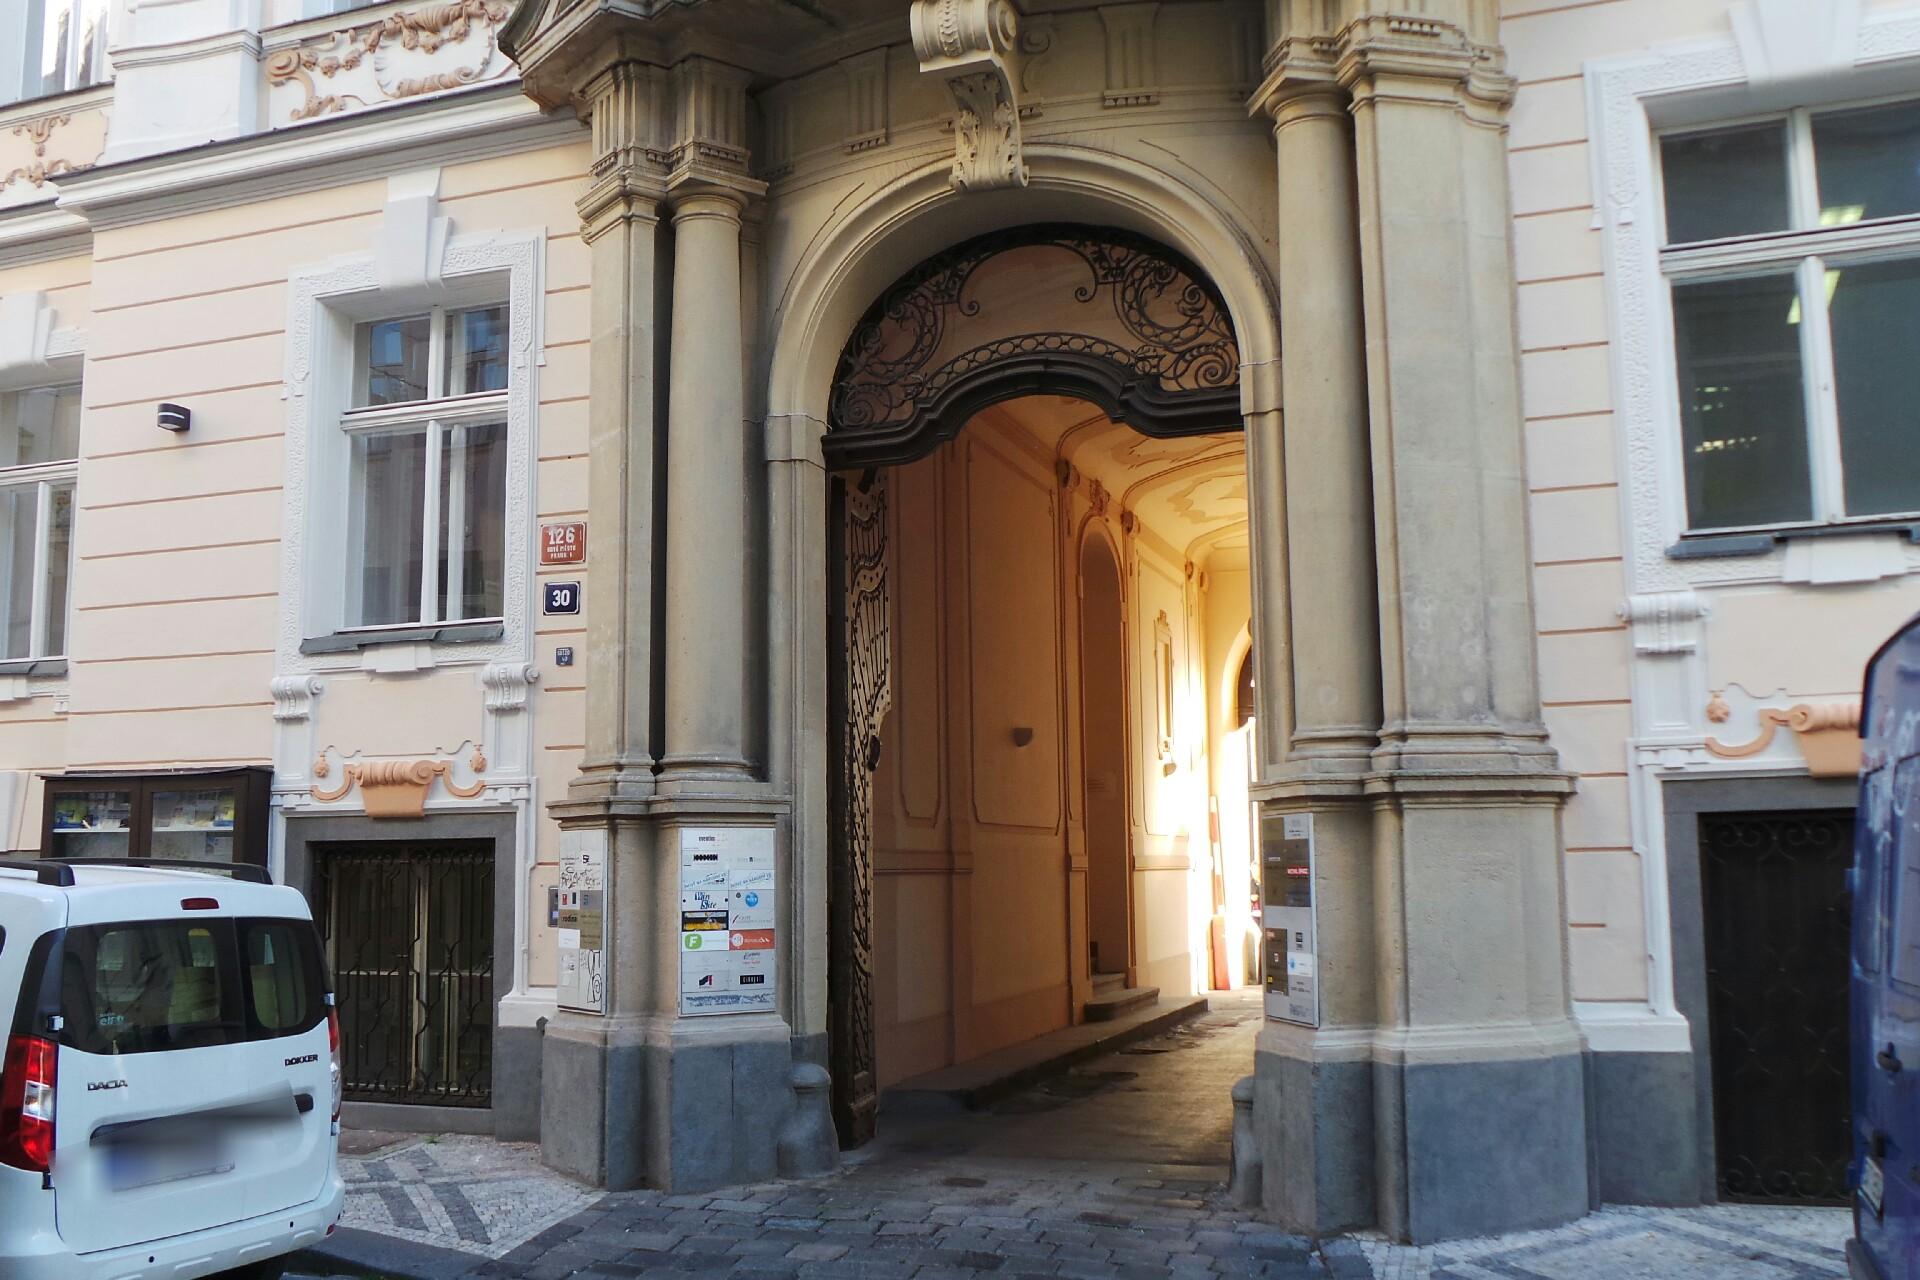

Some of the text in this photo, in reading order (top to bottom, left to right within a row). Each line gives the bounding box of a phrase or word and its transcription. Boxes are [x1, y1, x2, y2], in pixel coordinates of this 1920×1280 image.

[548, 527, 575, 545] 126
[552, 589, 570, 607] 30
[284, 1054, 319, 1066] DOKKER
[87, 1080, 128, 1091] DACIA
